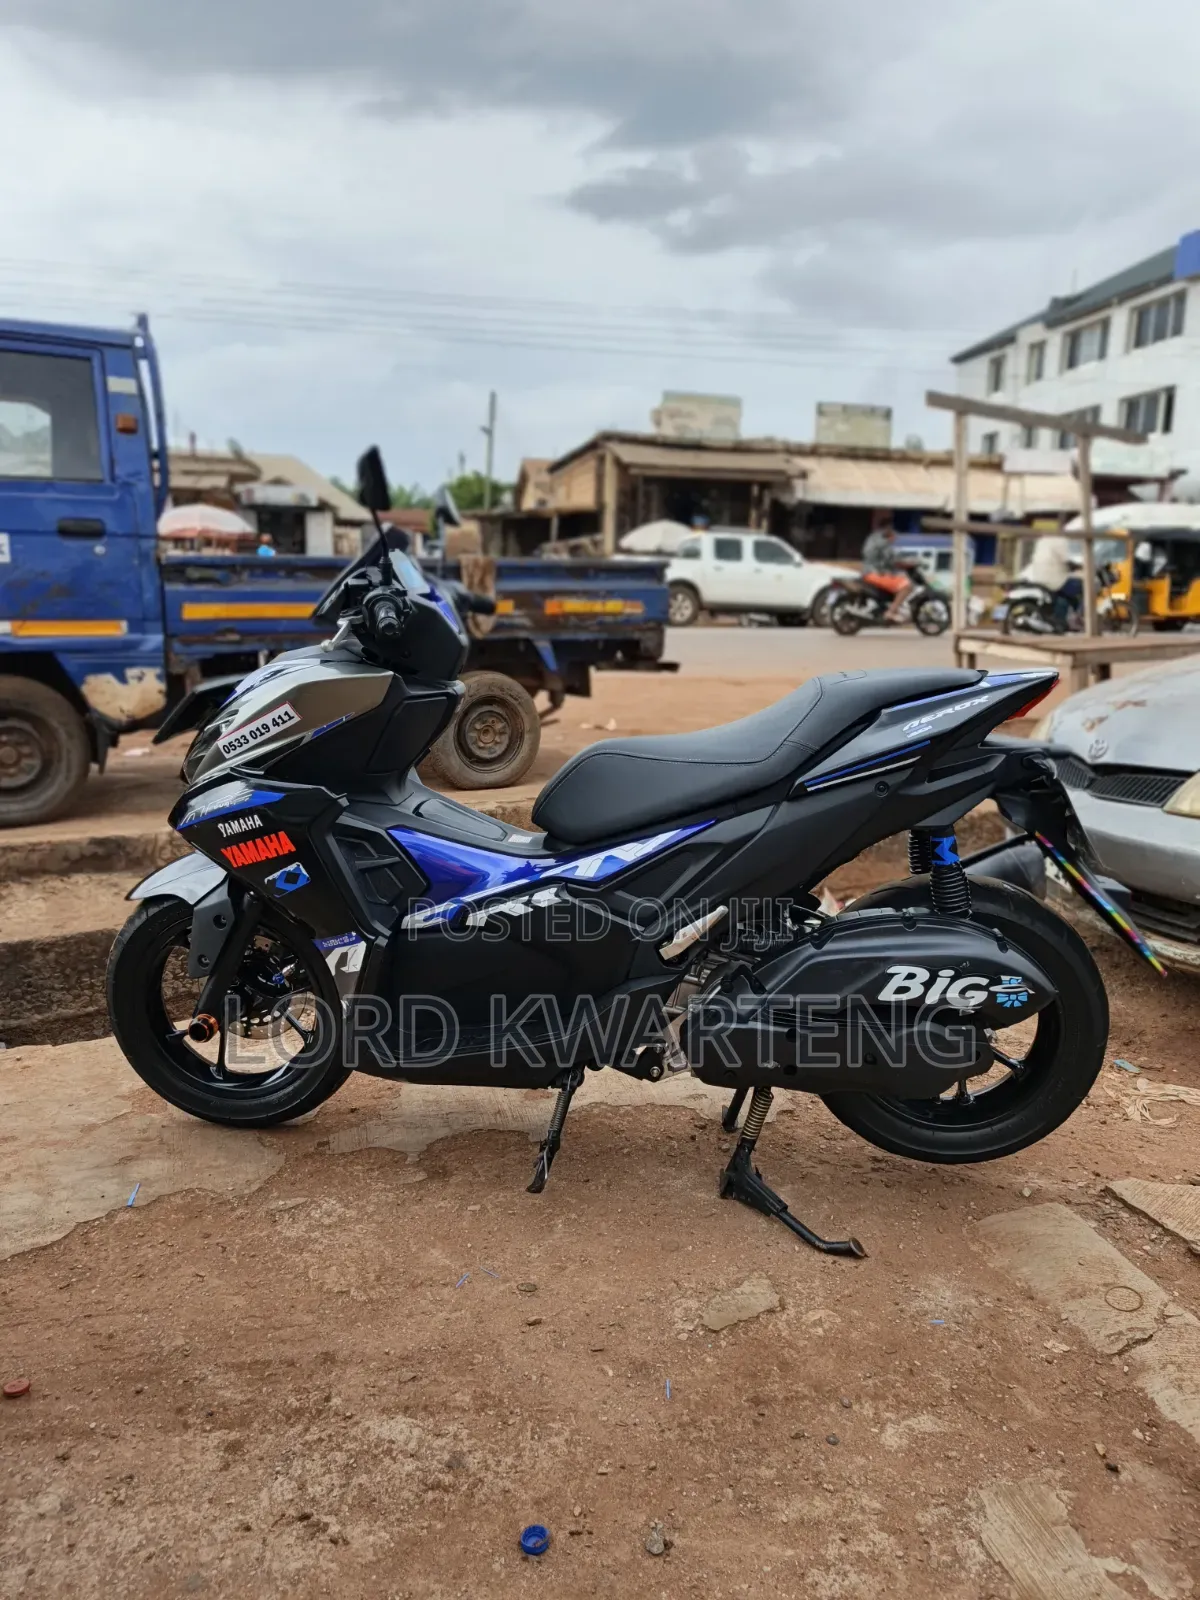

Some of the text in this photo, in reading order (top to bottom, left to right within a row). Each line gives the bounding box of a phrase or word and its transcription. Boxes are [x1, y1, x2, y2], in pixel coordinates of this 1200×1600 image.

[222, 710, 295, 755] 0533 019 411
[217, 814, 263, 838] YAMAHA
[221, 831, 296, 868] YAMAHA
